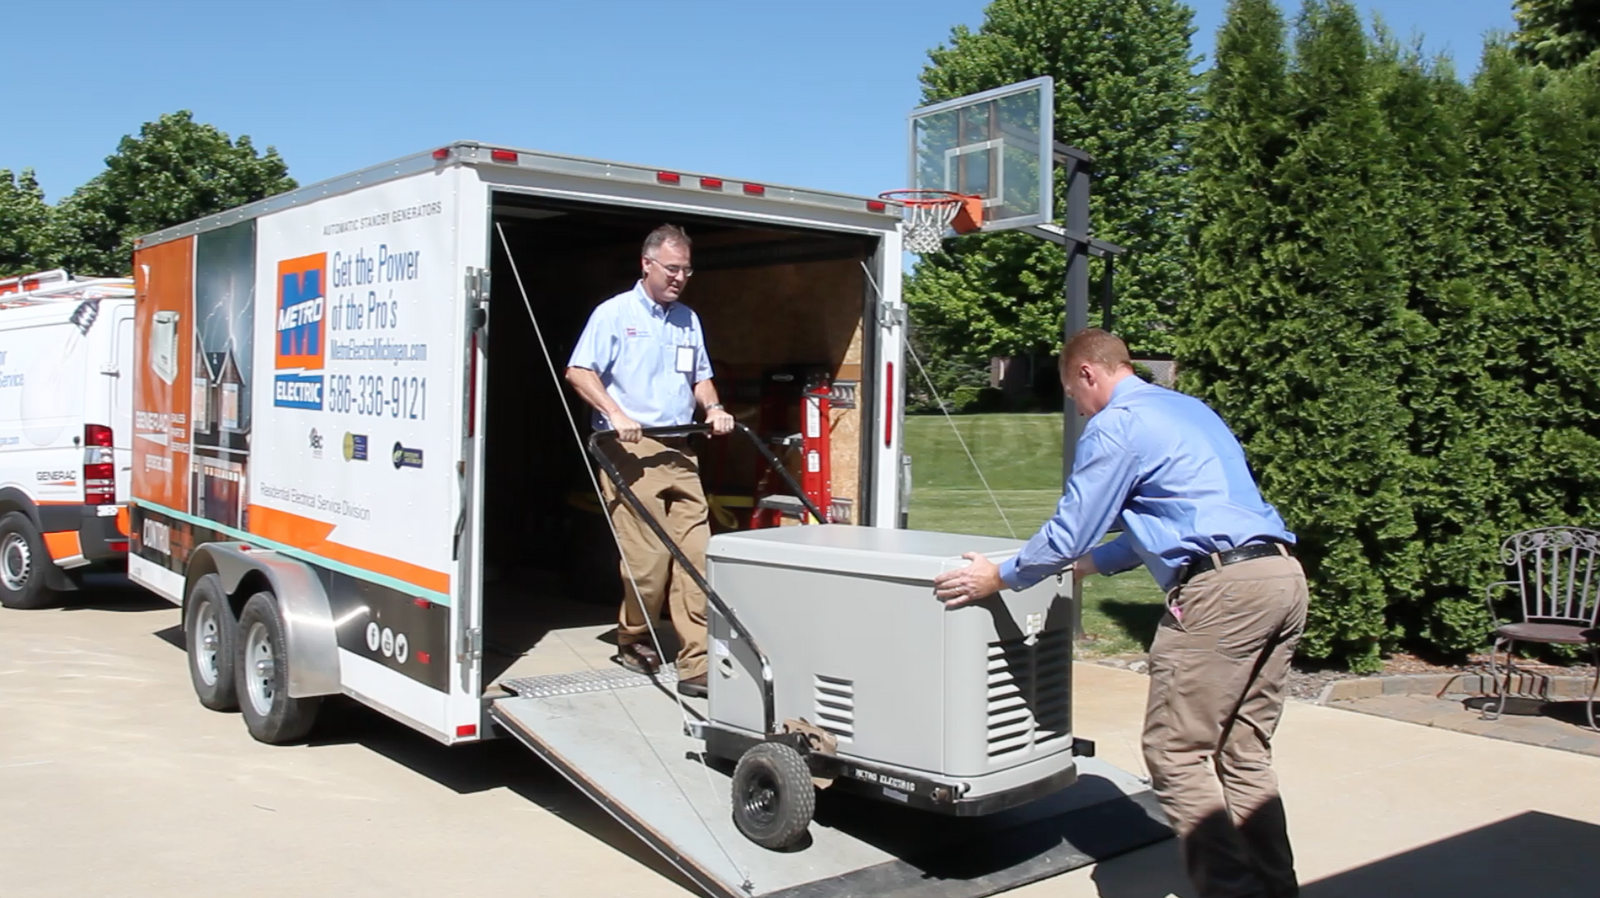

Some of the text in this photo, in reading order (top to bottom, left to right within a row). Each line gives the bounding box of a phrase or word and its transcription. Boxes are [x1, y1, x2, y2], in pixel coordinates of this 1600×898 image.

[323, 201, 442, 236] AUTOMATIC STANDBY GENERATORS
[333, 244, 420, 288] Get the Power
[277, 296, 325, 331] METRO
[331, 289, 398, 331] of the Pro's
[331, 338, 427, 366] MetroElectricMichigan.com
[276, 381, 322, 403] ELECTRIC
[329, 374, 427, 420] 586-336-9121
[136, 410, 169, 432] GENERAC
[36, 470, 77, 481] GENERAC
[260, 481, 371, 521] Residential Electrical Service Division
[855, 768, 916, 792] METRO ELECTRIC
